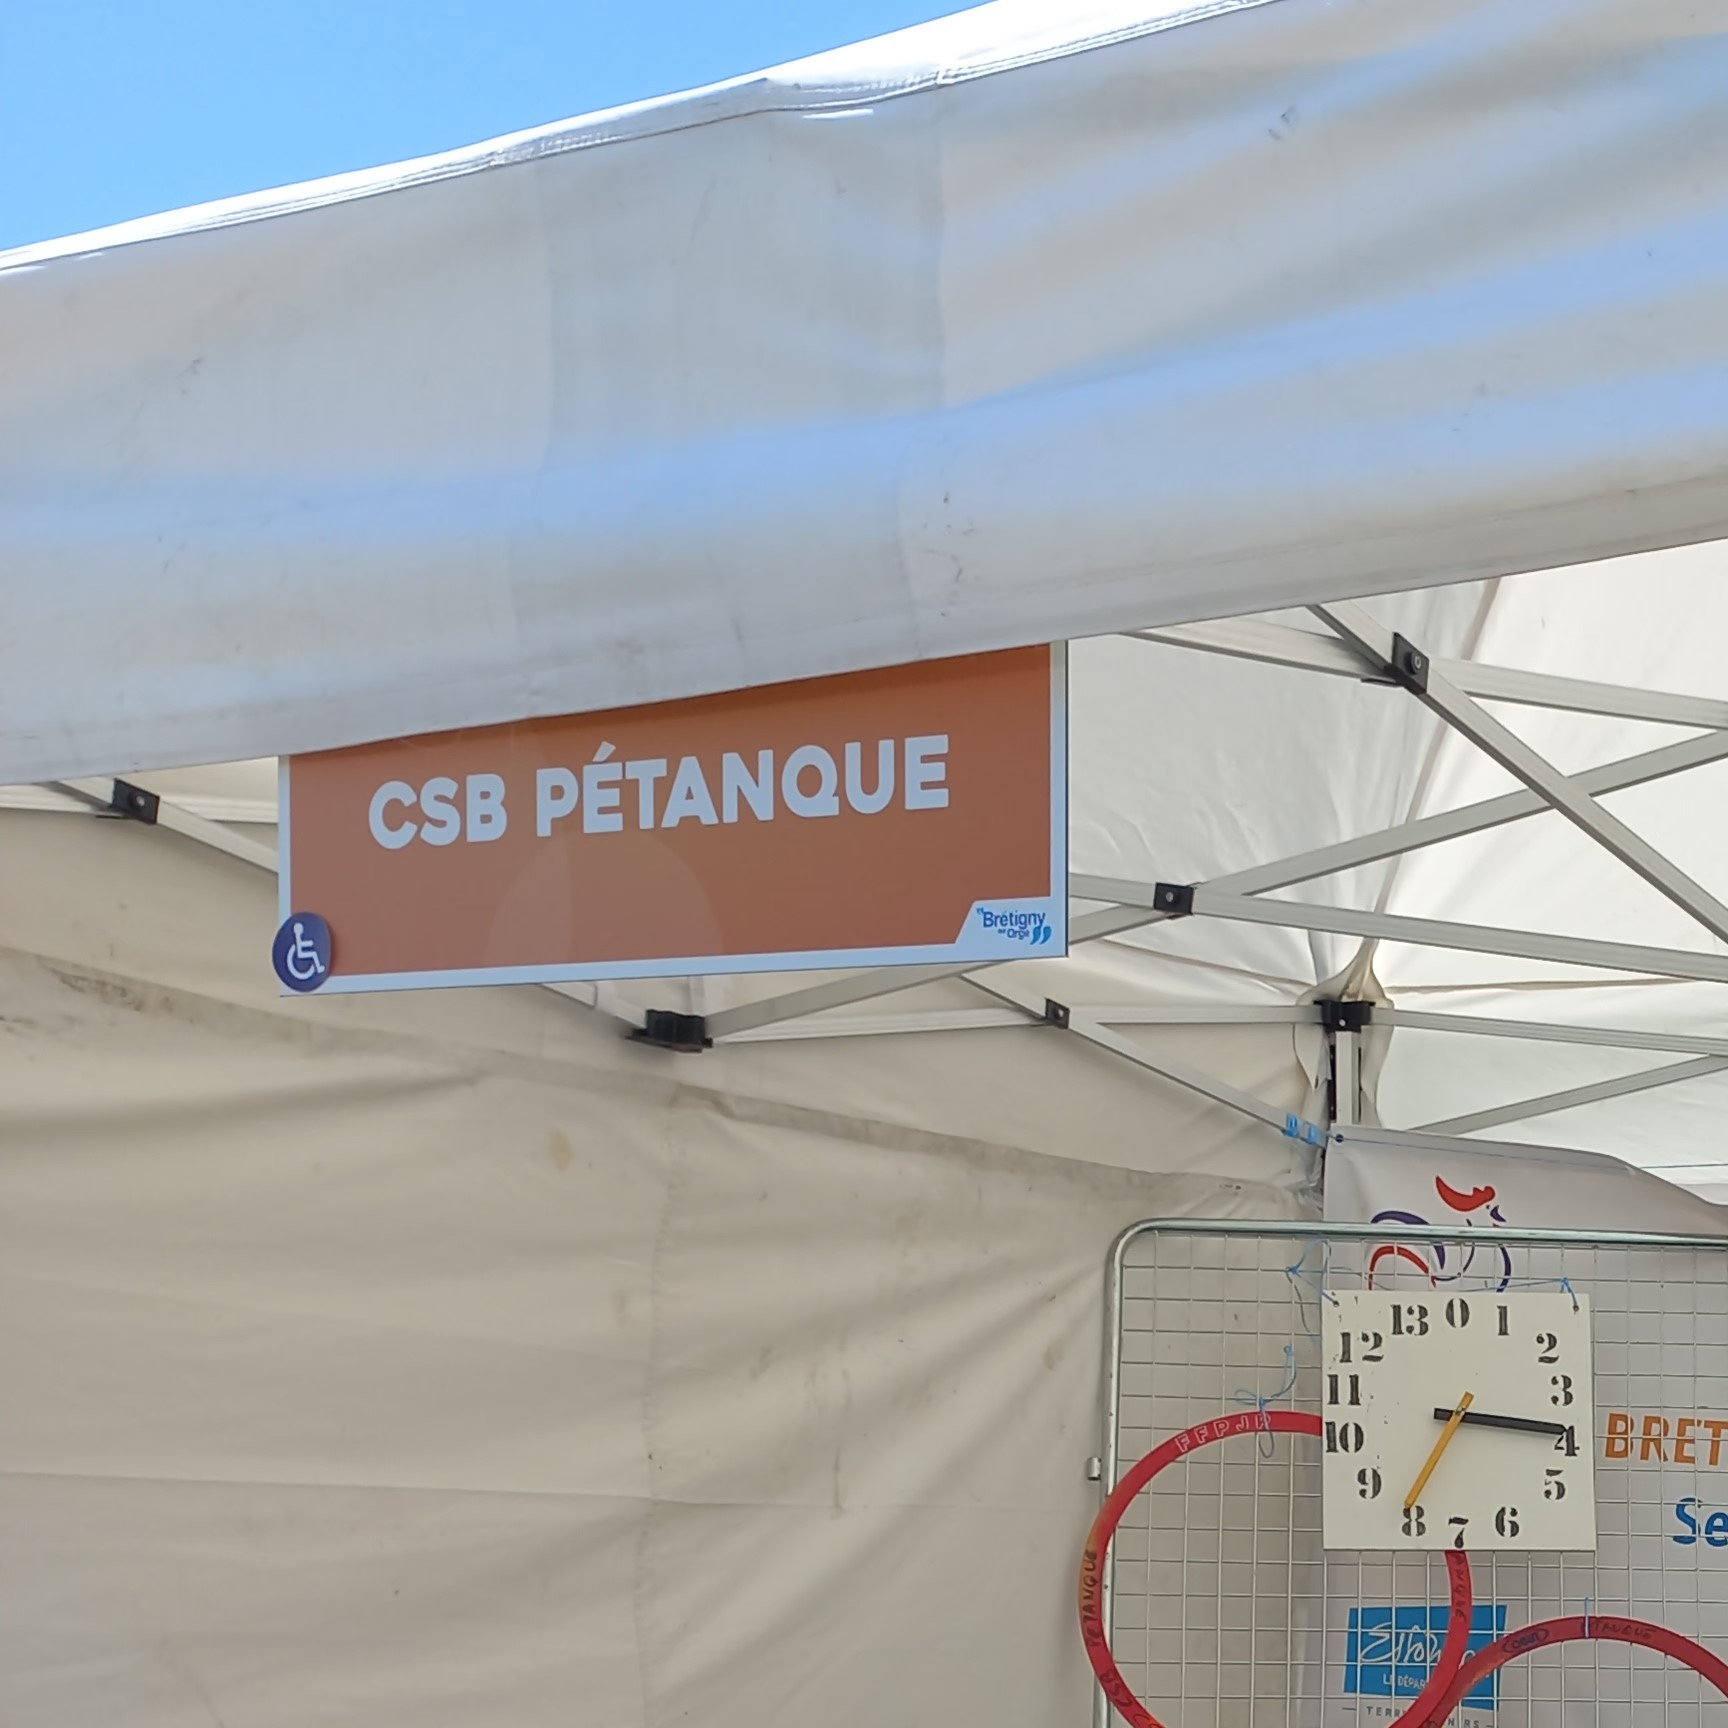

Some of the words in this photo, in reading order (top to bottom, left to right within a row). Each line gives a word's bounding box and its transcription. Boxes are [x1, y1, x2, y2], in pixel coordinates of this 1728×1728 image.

[368, 774, 508, 850] CSB
[536, 734, 949, 837] PÉTANQUE
[983, 910, 1047, 930] Brétigny
[1390, 1304, 1429, 1336] 13
[1445, 1298, 1470, 1328] 0
[1497, 1305, 1509, 1336] 1
[1339, 1332, 1384, 1363] 12
[1536, 1333, 1560, 1364] 2
[1327, 1374, 1361, 1406] 11
[1550, 1375, 1573, 1406] 3
[1325, 1421, 1364, 1453] 10
[1554, 1425, 1580, 1457] 4
[1357, 1468, 1382, 1499] 9
[1544, 1469, 1566, 1500] 5
[1401, 1505, 1426, 1537] 8
[1448, 1517, 1469, 1549] 7
[1495, 1507, 1520, 1538] 6
